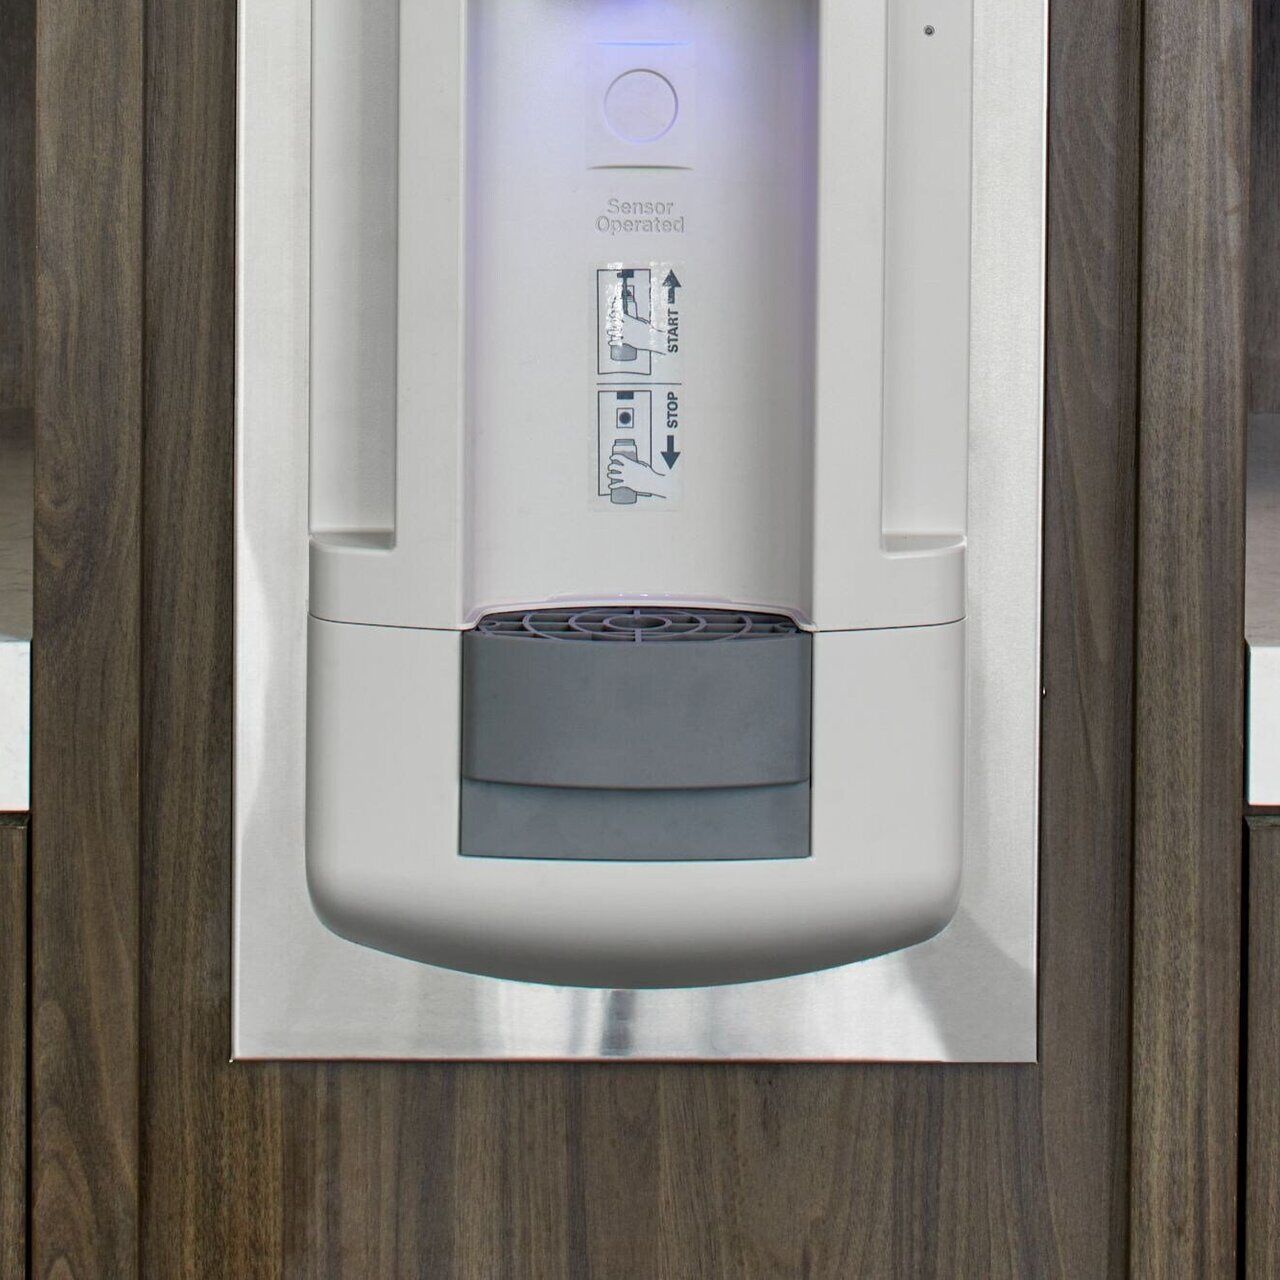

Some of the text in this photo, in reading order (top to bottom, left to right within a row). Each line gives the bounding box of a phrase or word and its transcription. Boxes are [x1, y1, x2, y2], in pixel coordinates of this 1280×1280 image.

[607, 198, 674, 215] Sensor
[596, 215, 685, 236] Operated
[667, 308, 679, 353] START
[666, 391, 678, 429] STOP
